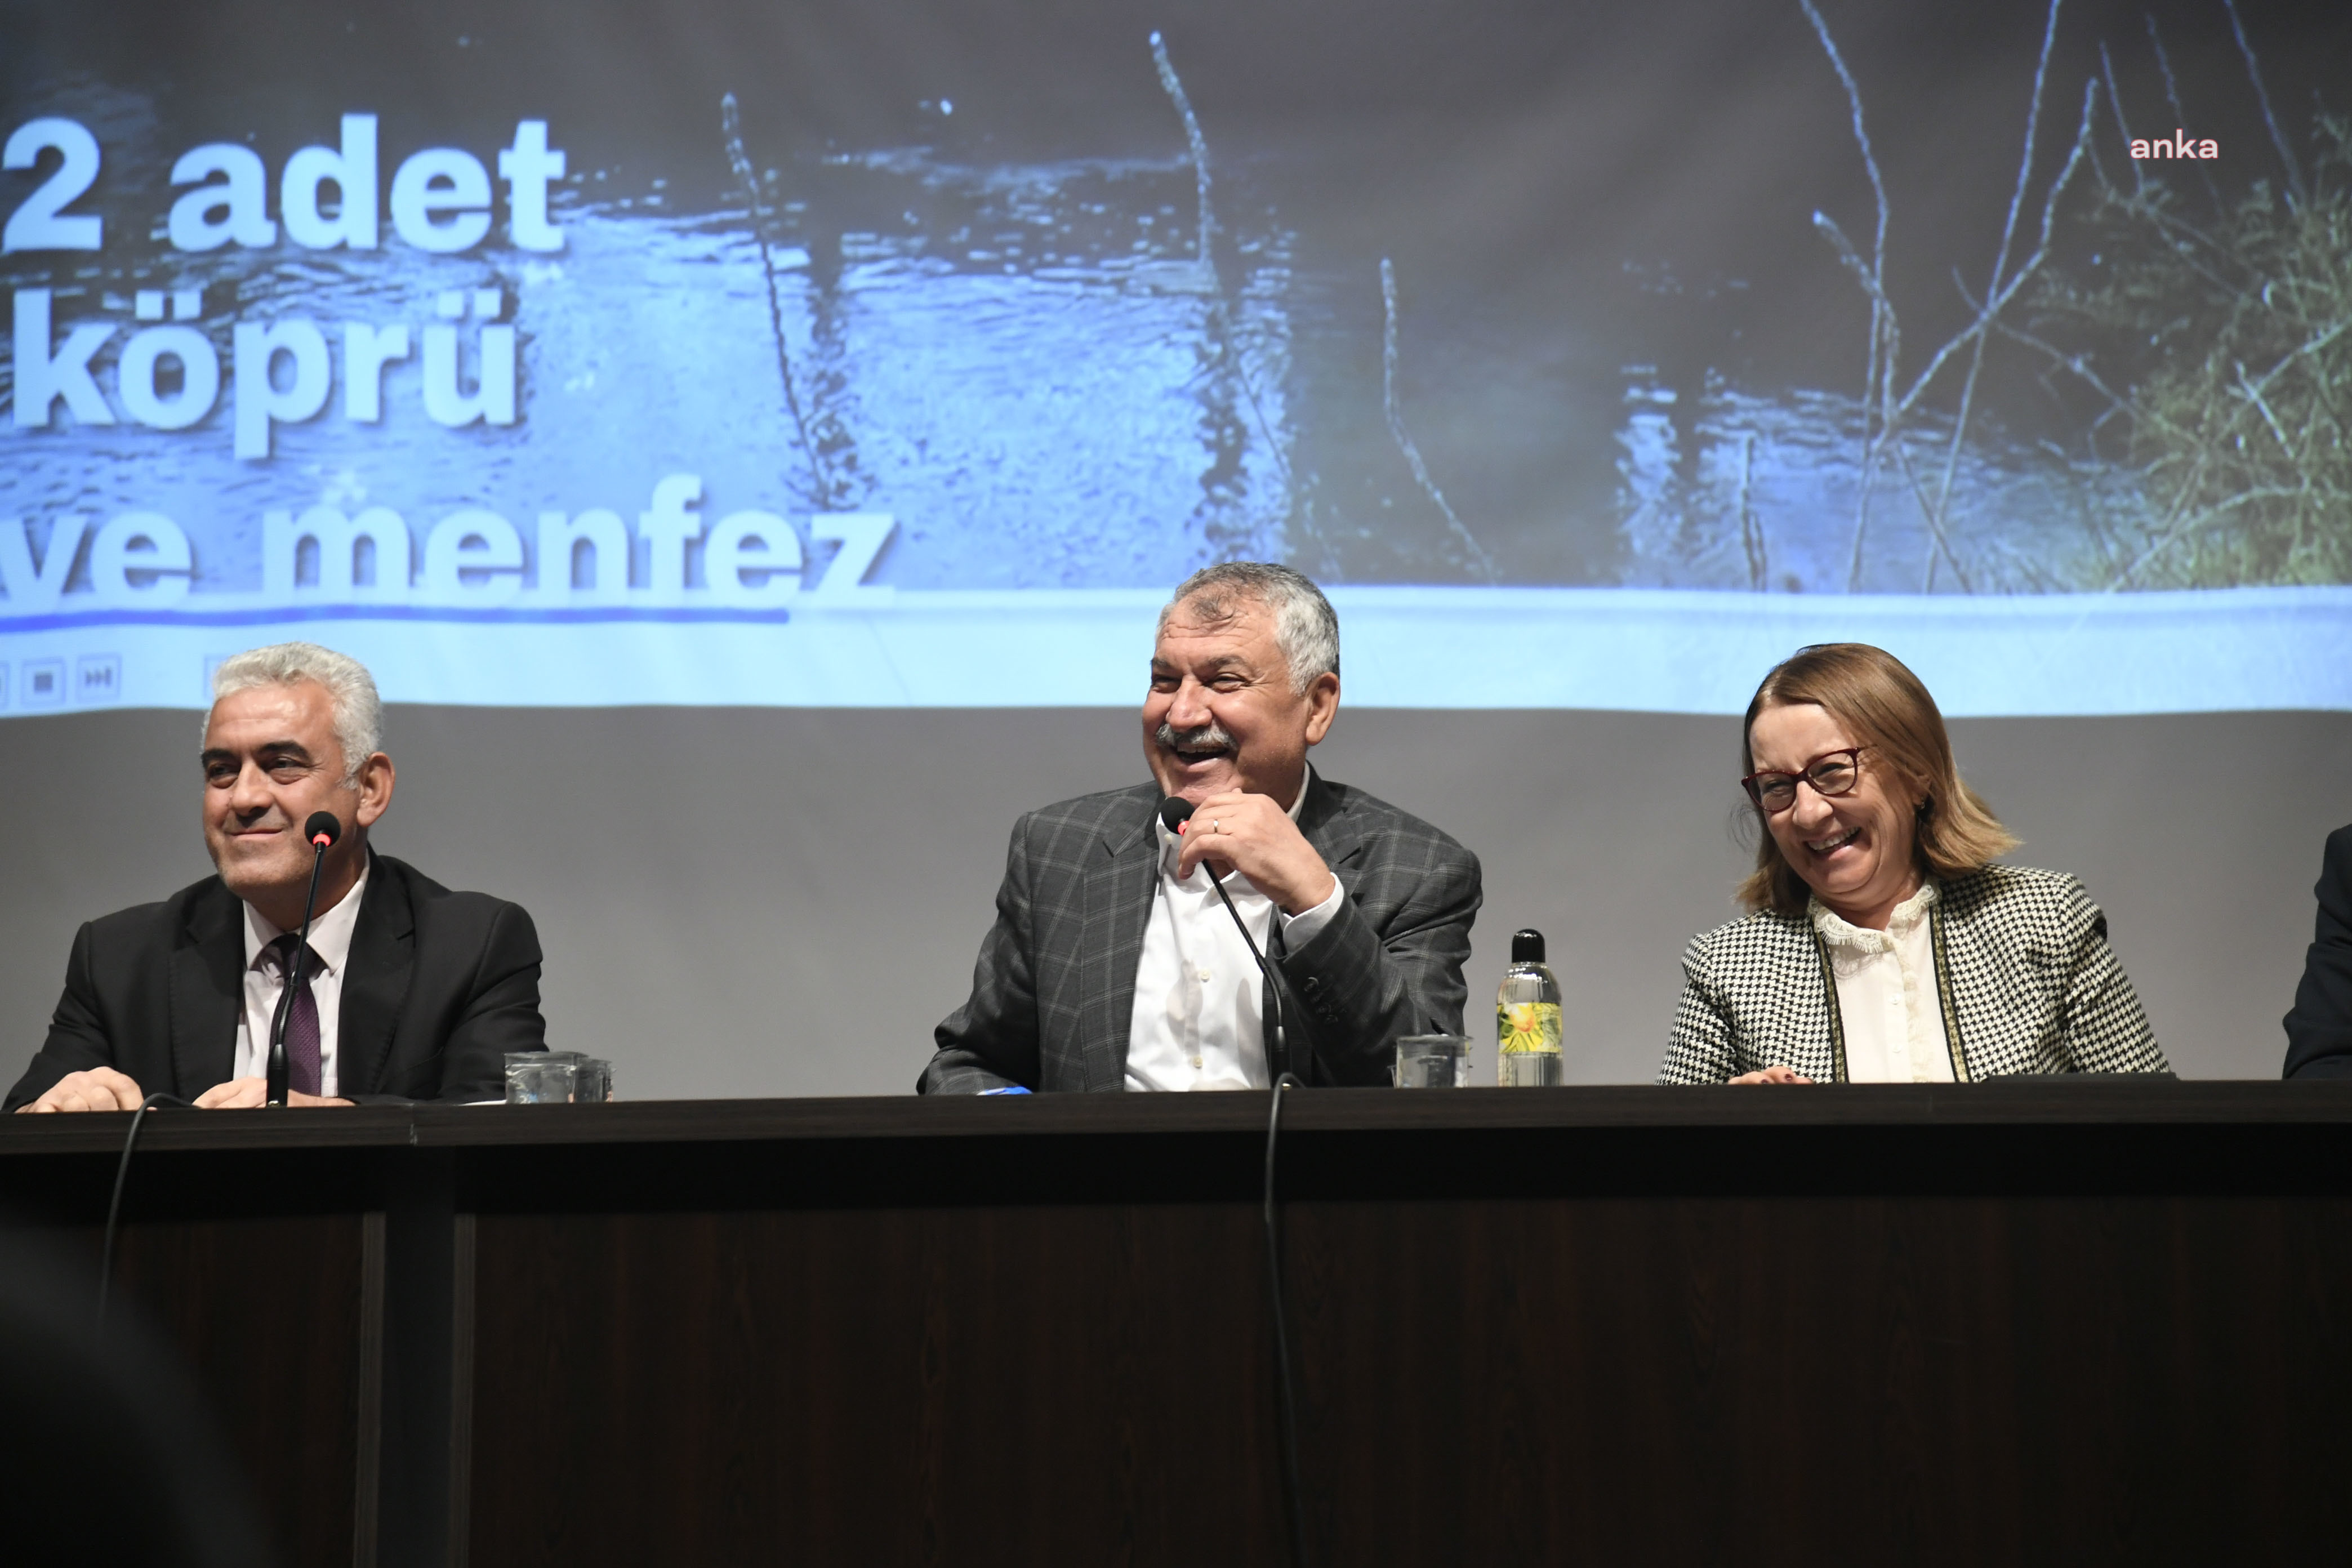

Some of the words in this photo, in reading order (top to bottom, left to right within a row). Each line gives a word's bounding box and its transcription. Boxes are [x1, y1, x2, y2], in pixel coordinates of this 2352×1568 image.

[3, 117, 102, 251] 2
[168, 114, 565, 253] adet
[13, 288, 515, 459] köprü
[0, 513, 191, 611] ve
[263, 473, 896, 608] menfez
